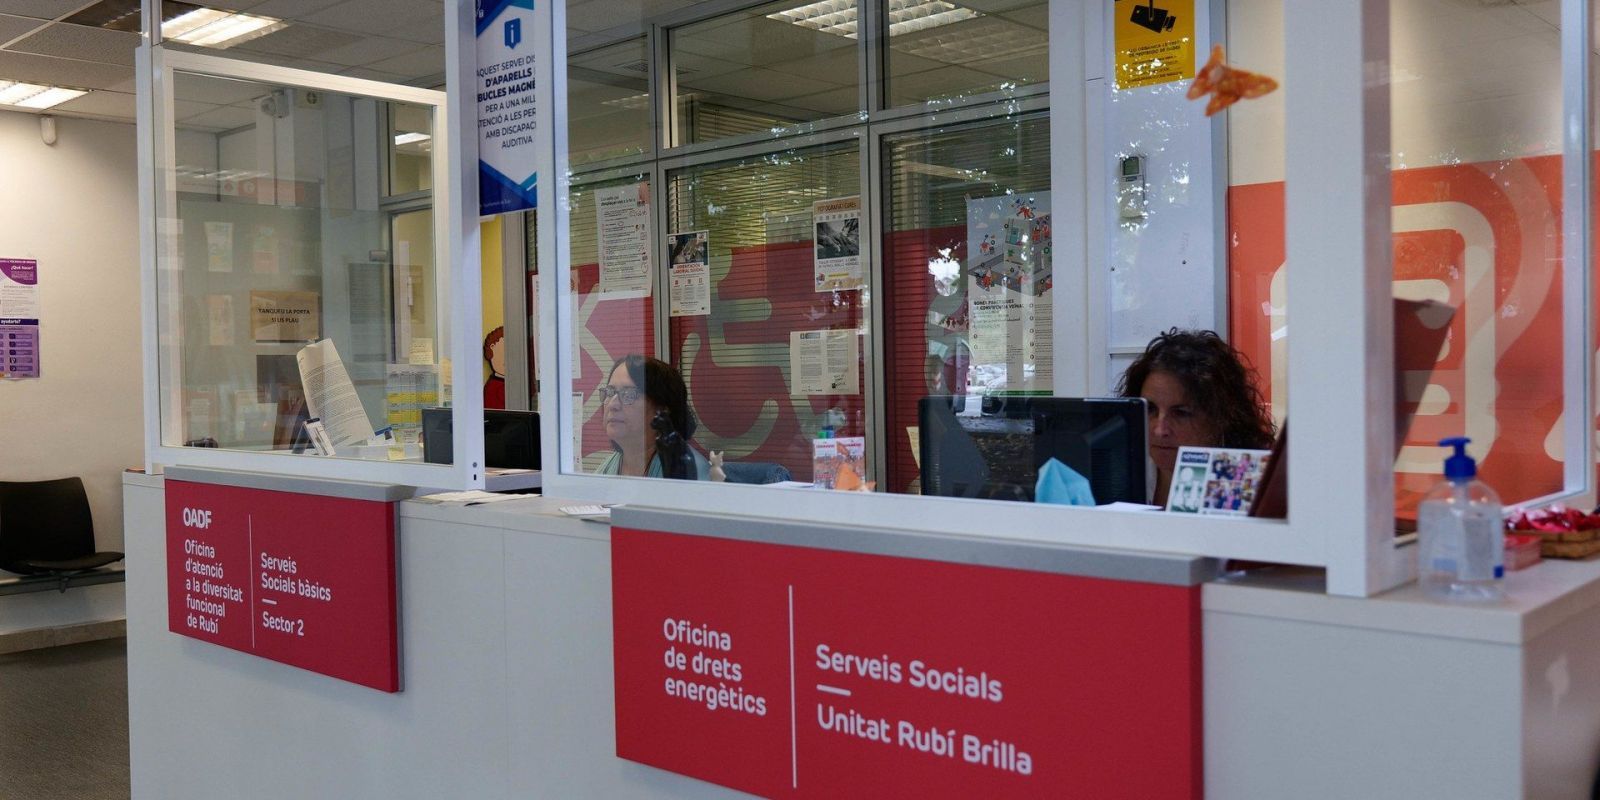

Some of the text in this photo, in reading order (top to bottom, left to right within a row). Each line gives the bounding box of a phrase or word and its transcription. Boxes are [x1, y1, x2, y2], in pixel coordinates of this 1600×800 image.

[501, 58, 524, 71] SERVEI
[486, 67, 532, 88] D'APARELLS
[477, 87, 507, 103] BUCLES
[486, 103, 499, 113] PER
[500, 102, 504, 110] A
[506, 98, 520, 109] UNA
[478, 113, 503, 129] TENCIÓ
[504, 114, 509, 122] A
[510, 111, 522, 121] LES
[486, 129, 500, 139] AMB
[502, 136, 533, 149] AUDITIVA
[183, 507, 212, 529] OADF
[185, 539, 215, 559] Oficina
[185, 558, 224, 579] d'atenció
[261, 552, 297, 574] Serveis
[186, 578, 243, 603] a la diversitat
[261, 573, 331, 601] Socials bàsics
[186, 594, 225, 617] funcional
[187, 613, 219, 634] de Rubí
[262, 611, 305, 637] Sector 2
[663, 618, 732, 651] Oficina
[664, 646, 742, 682] de drets
[816, 644, 1003, 702] Serveis Socials
[665, 677, 767, 716] energètics
[817, 703, 1033, 775] Unitat Rubí Brilla
